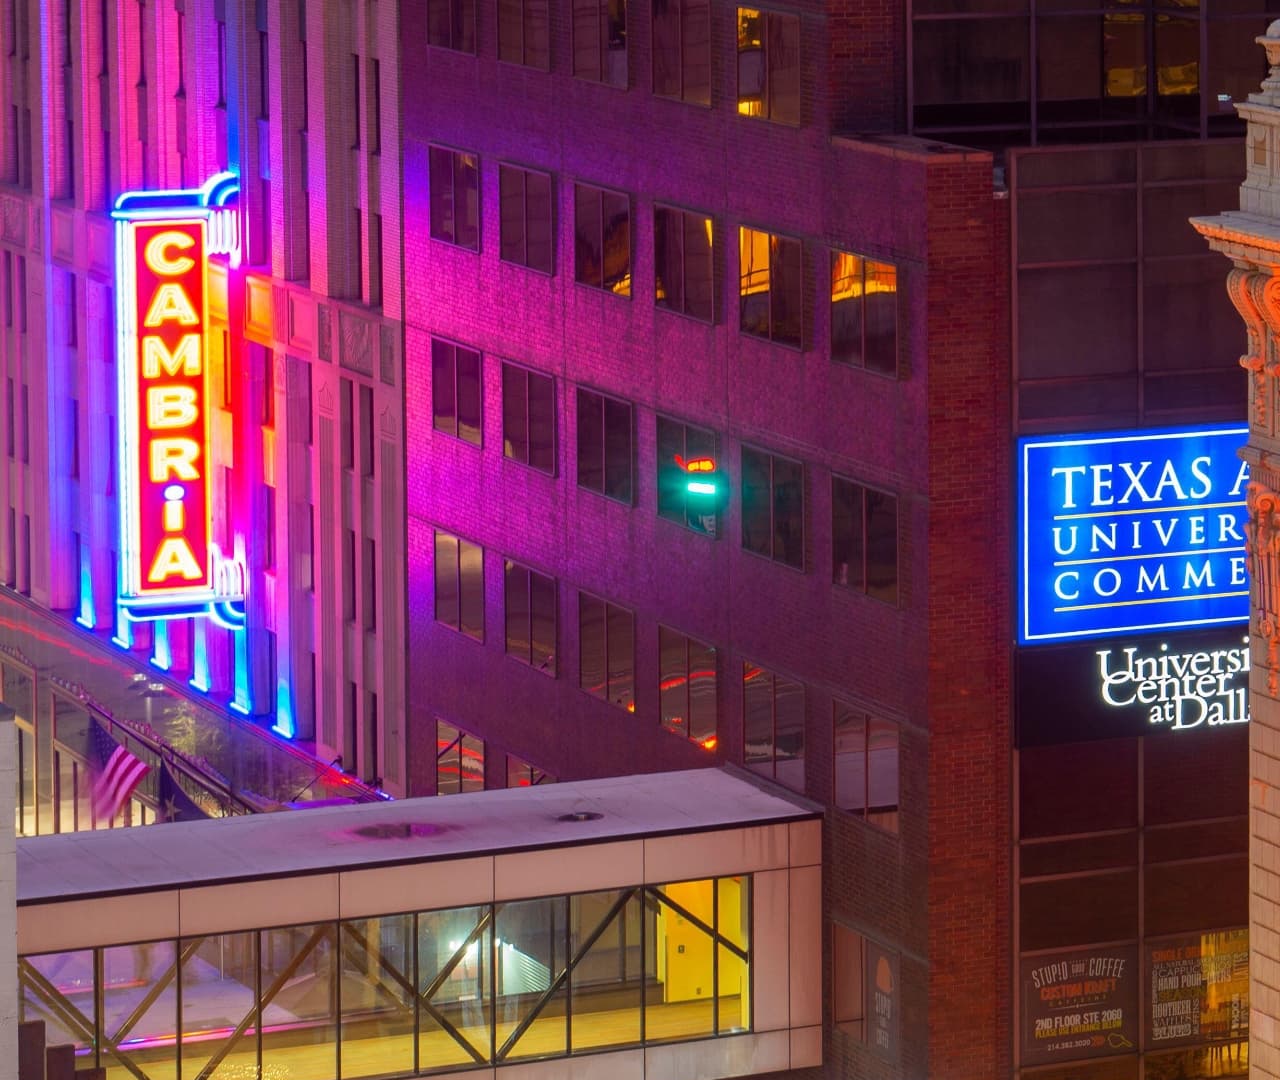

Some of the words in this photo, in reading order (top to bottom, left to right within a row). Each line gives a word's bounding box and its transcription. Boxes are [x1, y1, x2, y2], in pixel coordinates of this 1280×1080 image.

[1052, 456, 1212, 508] TEXAS
[1102, 671, 1233, 706] Center
[1150, 701, 1175, 723] at
[1171, 688, 1250, 730] Dall
[1089, 958, 1125, 978] COFFEE
[1158, 976, 1179, 991] HAND
[1035, 1017, 1053, 1031] 2ND
[1054, 1014, 1080, 1029] FLOOR
[1083, 1011, 1101, 1025] STE
